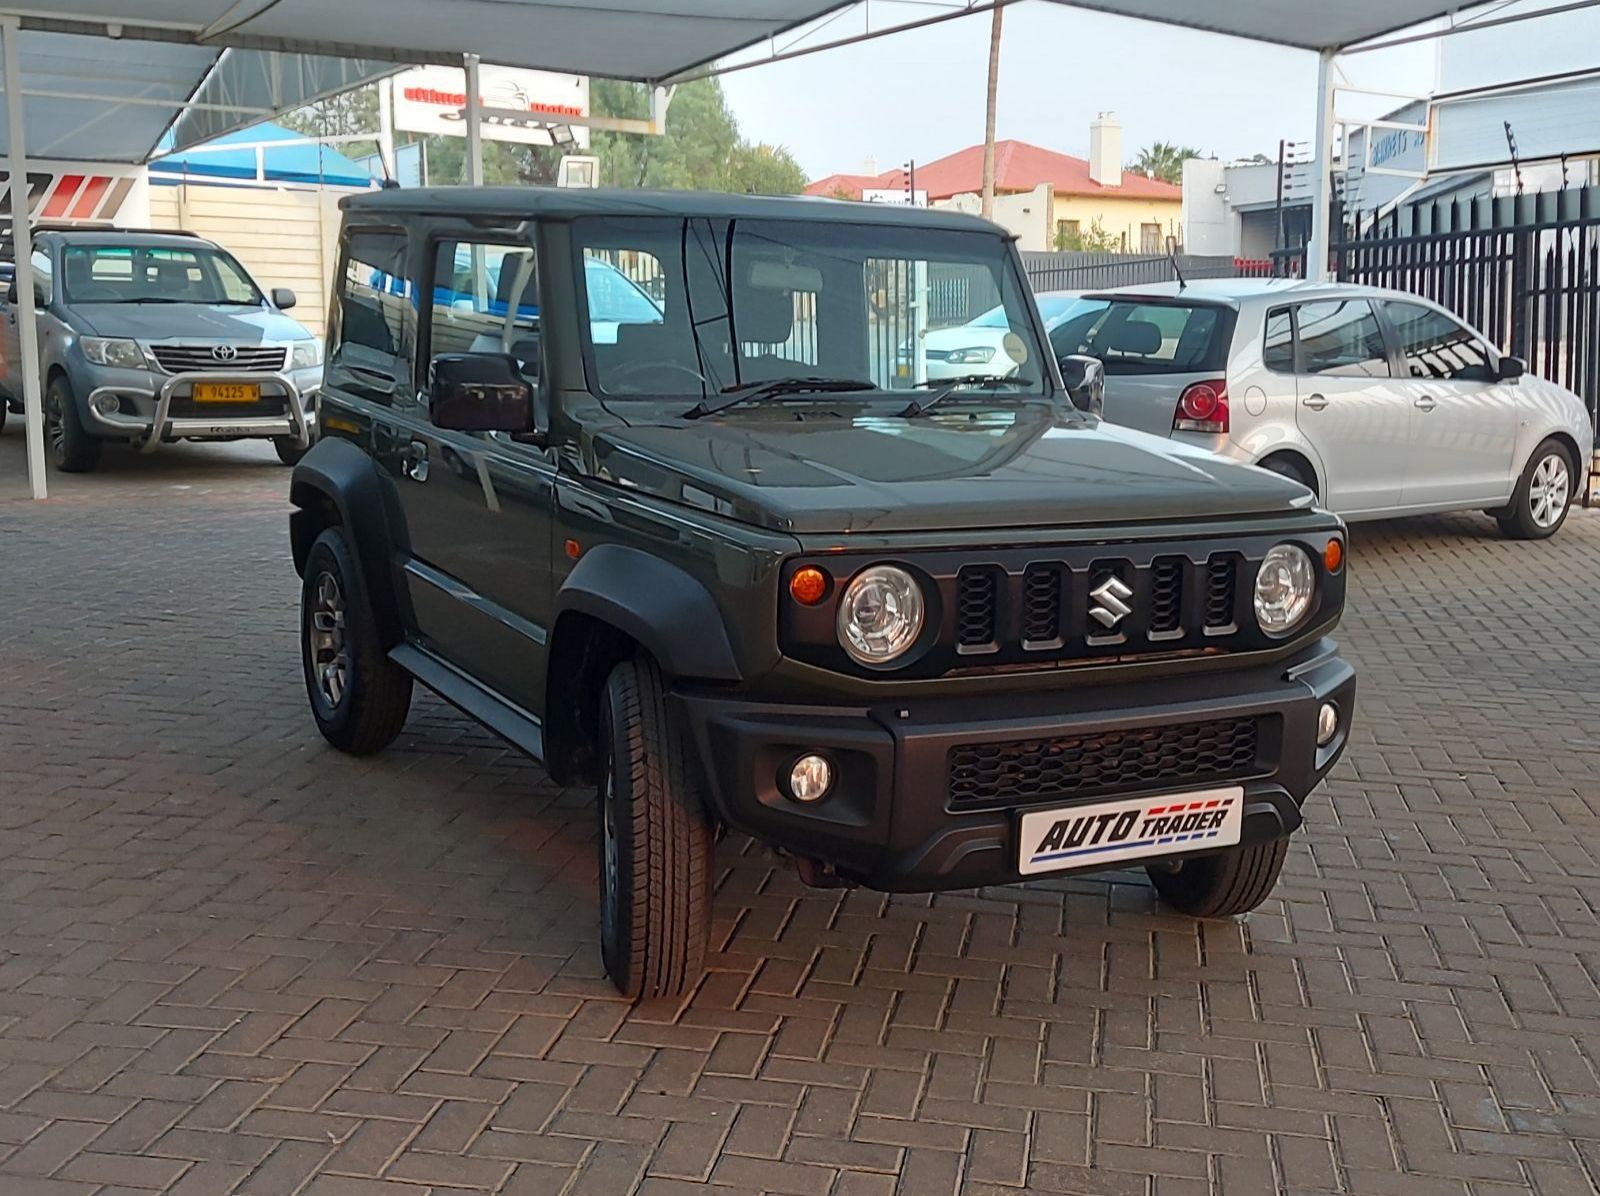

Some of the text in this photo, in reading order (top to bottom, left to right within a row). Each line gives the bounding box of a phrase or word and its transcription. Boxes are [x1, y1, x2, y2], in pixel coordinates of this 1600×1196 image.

[211, 386, 244, 398] 94125
[1035, 809, 1229, 853] AUTO TRADER
